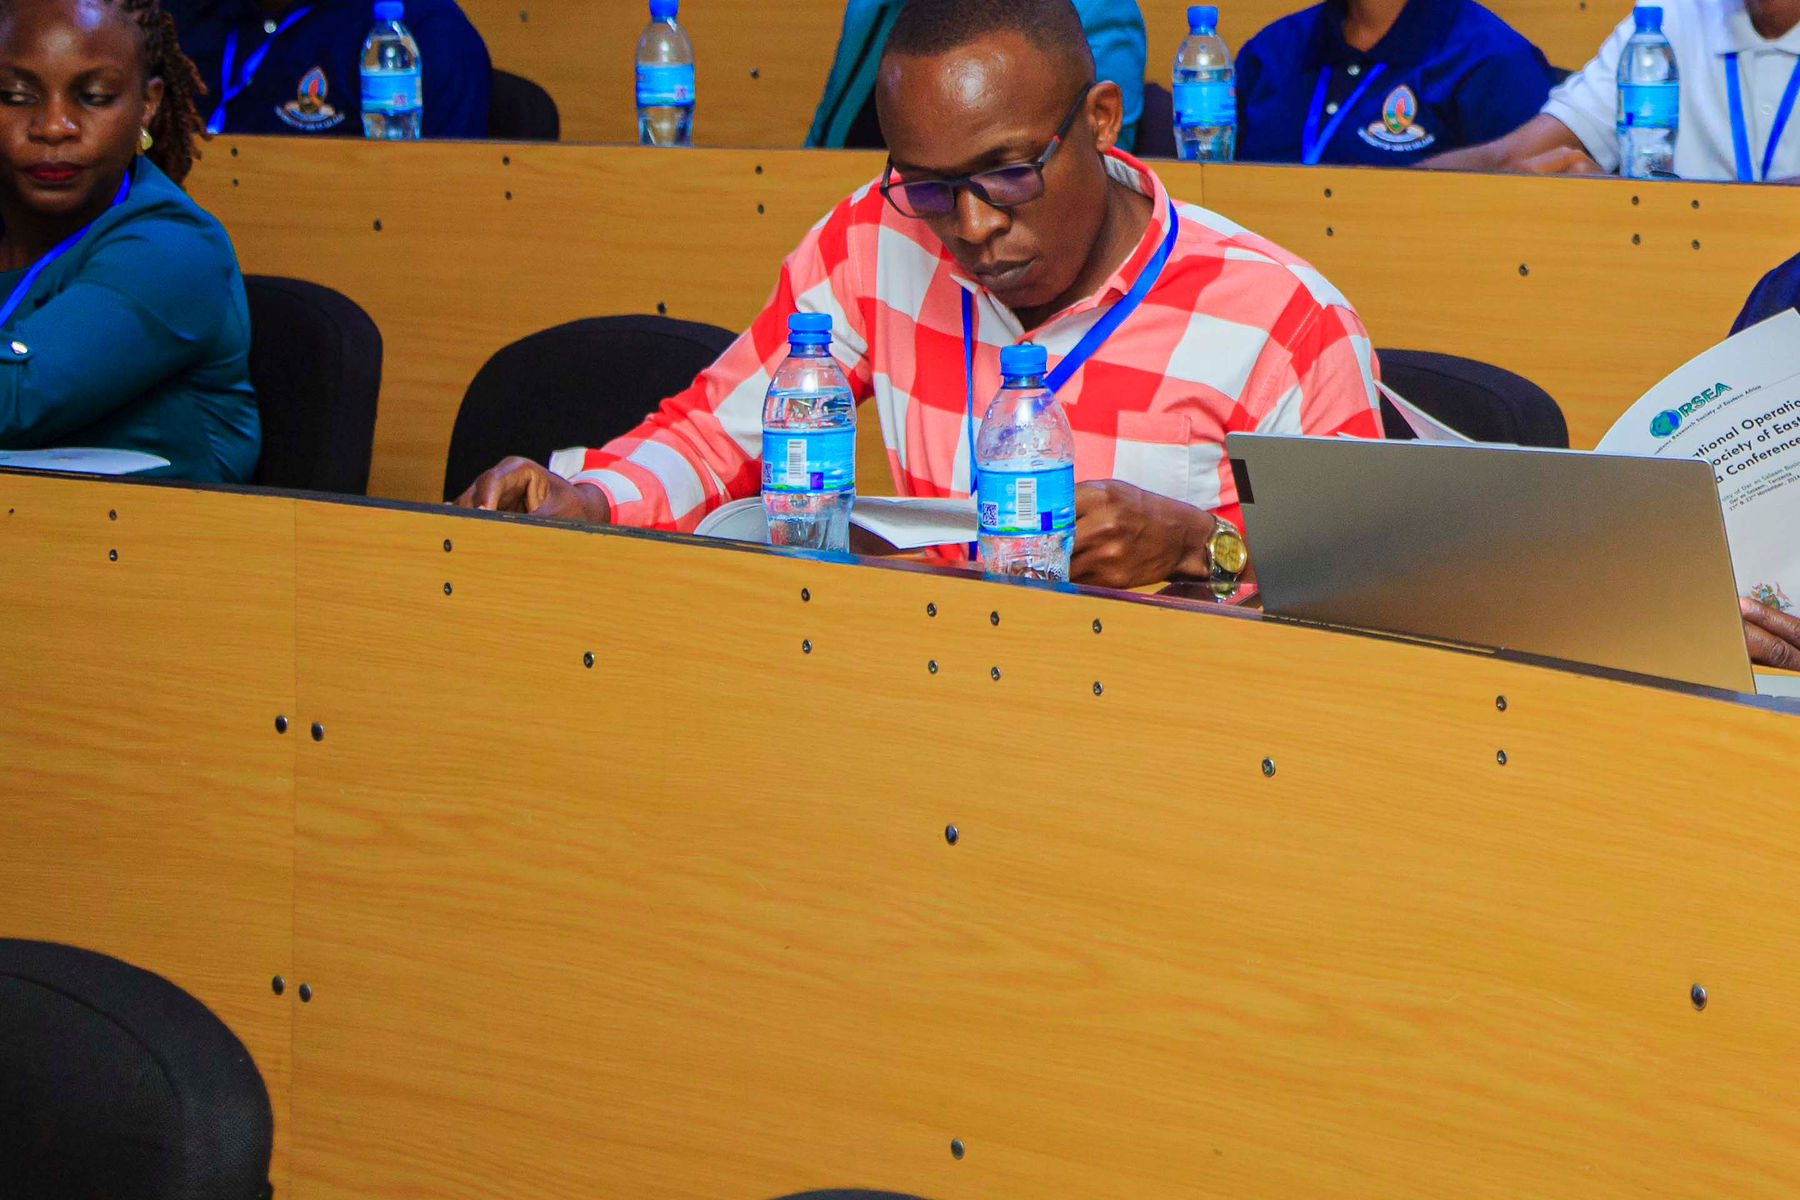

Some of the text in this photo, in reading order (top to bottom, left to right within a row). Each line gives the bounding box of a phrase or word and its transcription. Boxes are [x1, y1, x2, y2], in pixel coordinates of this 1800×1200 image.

[1696, 408, 1716, 422] Society
[1712, 440, 1753, 466] ociety
[1757, 429, 1771, 442] of
